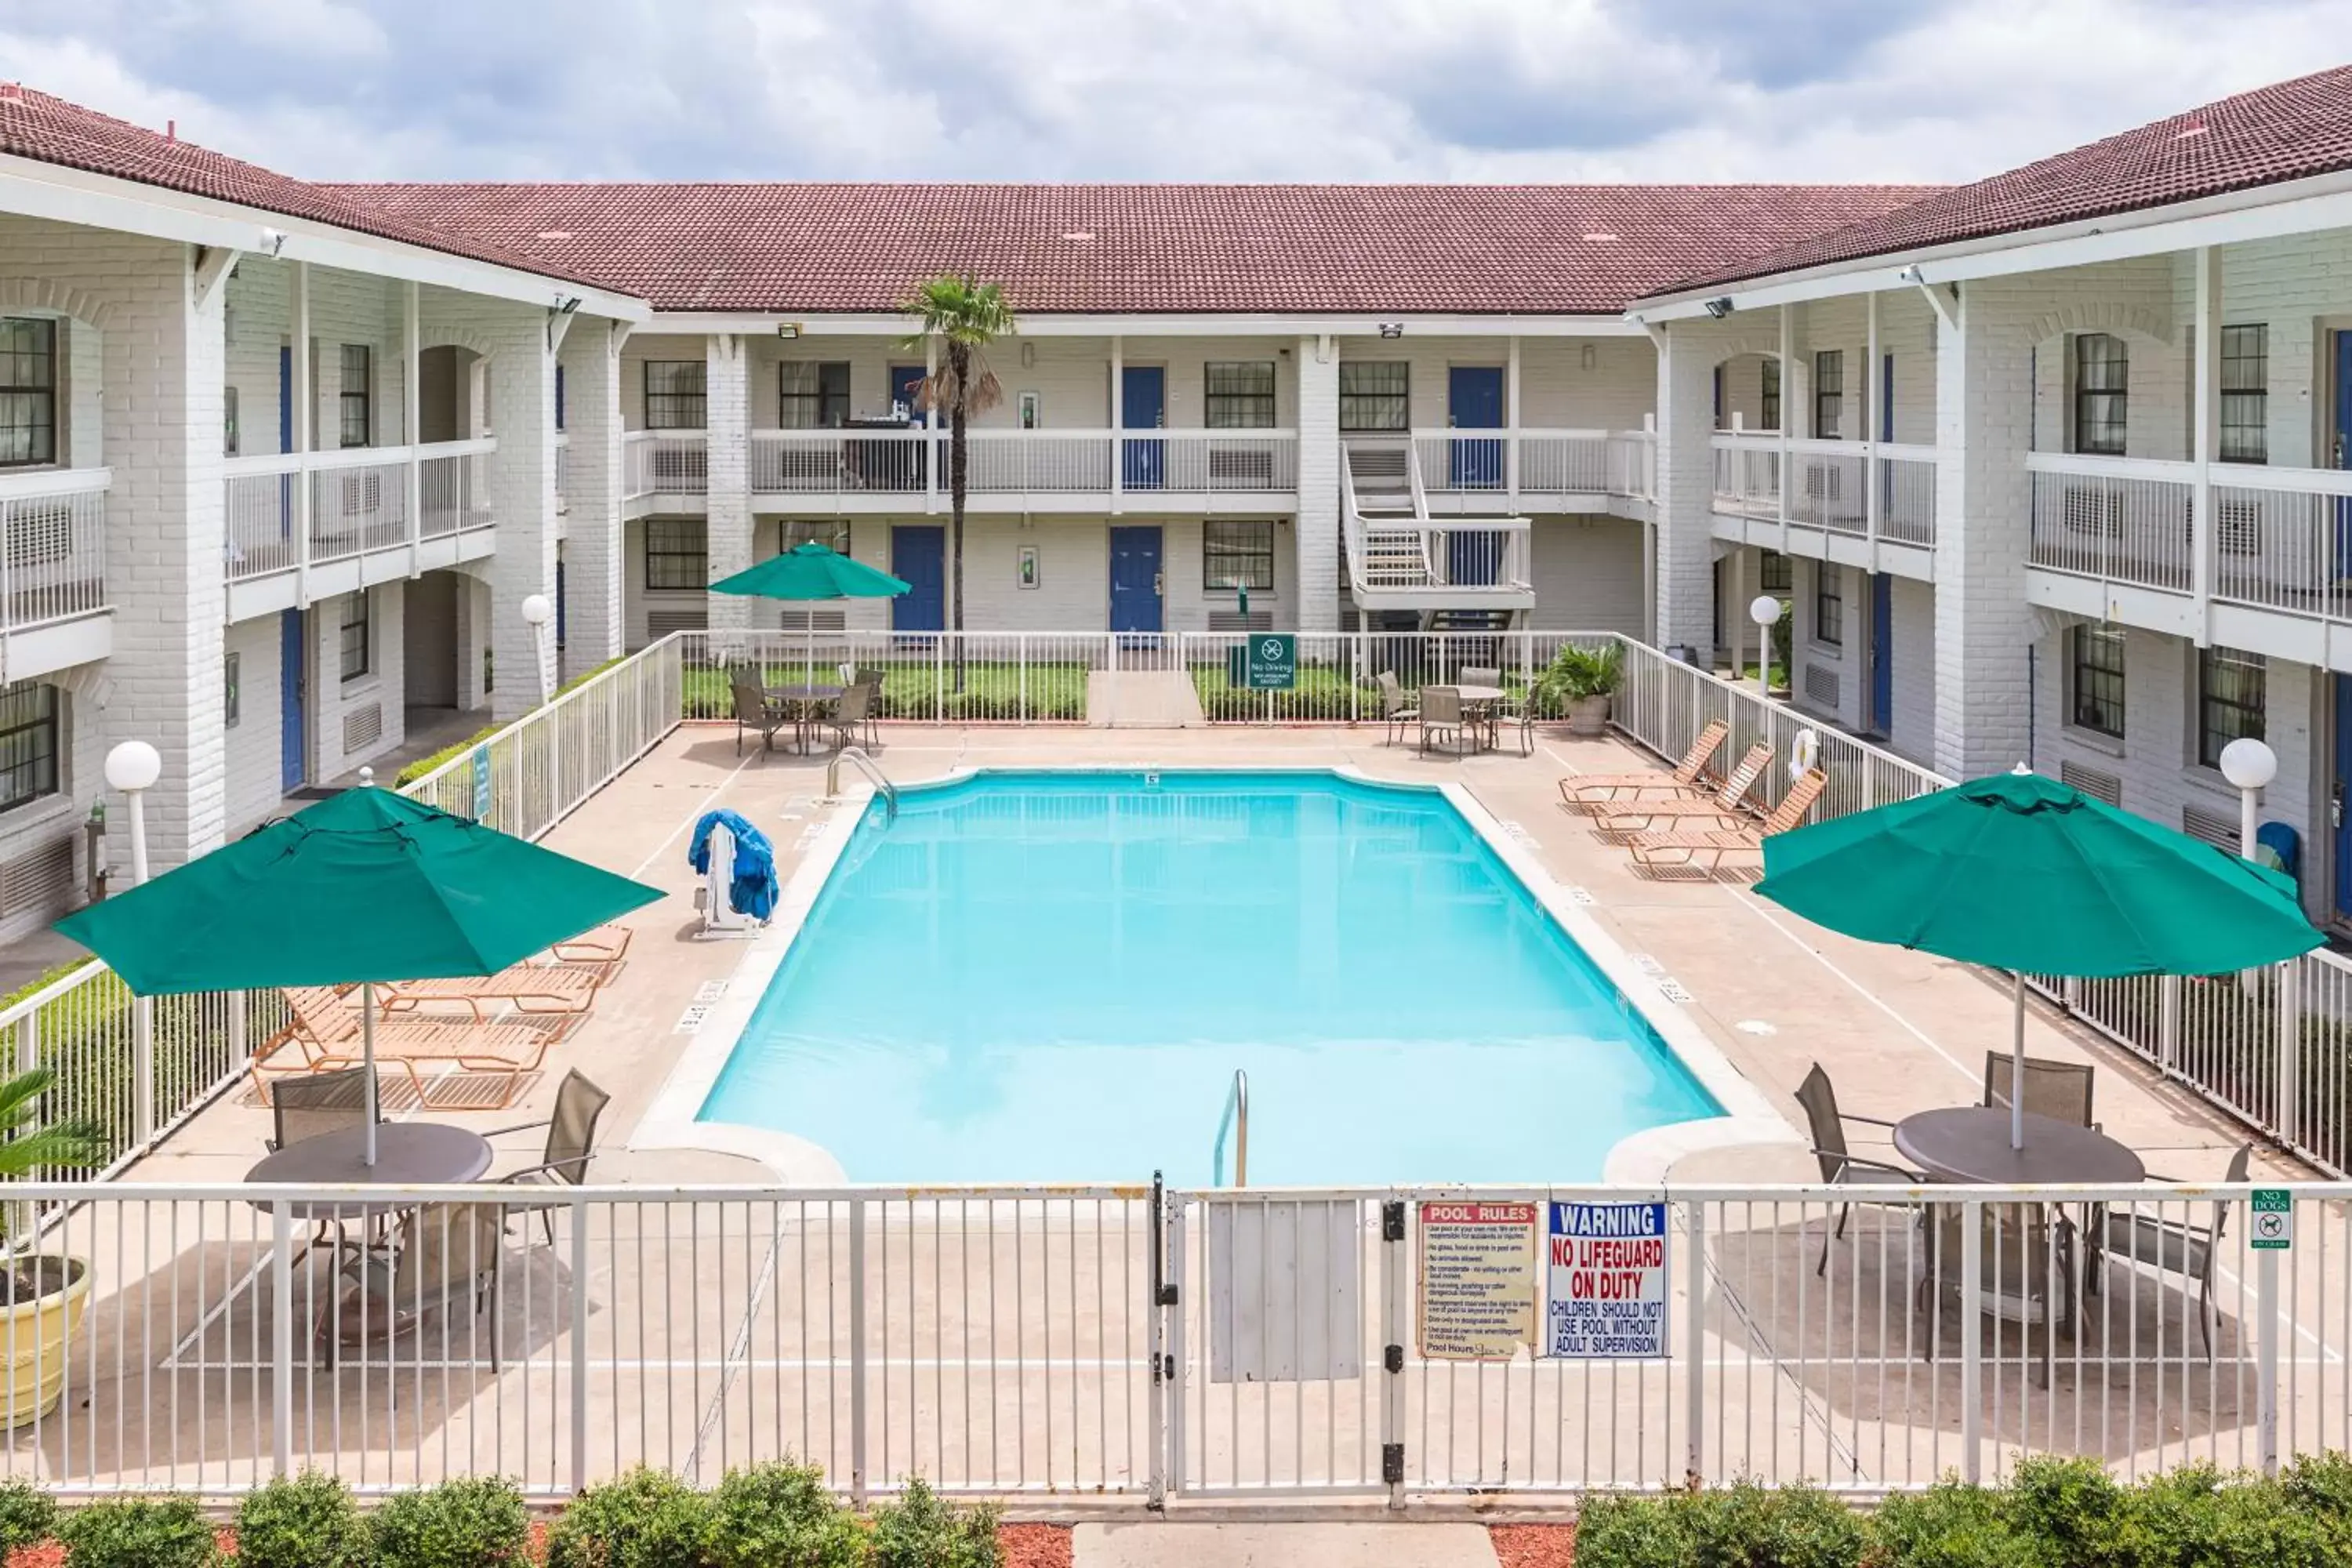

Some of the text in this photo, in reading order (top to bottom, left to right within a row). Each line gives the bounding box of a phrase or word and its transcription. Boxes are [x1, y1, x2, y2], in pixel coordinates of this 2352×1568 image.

[1251, 662, 1293, 673] No Diving
[2261, 1192, 2281, 1200] NO
[2256, 1201, 2288, 1211] DOGS
[1431, 1207, 1528, 1221] POOL RULES
[1559, 1205, 1655, 1235] WARNING
[1497, 1244, 1509, 1253] pool
[1552, 1238, 1663, 1269] NO LIFEGUARD
[1572, 1271, 1643, 1300] ON DUTY
[1551, 1301, 1663, 1318] CHILDREN SHOULD NOT
[1558, 1319, 1657, 1335] USE POOL WITHOUT
[1427, 1342, 1446, 1352] Pool
[1448, 1343, 1474, 1353] Hours
[1556, 1337, 1657, 1353] ADULT SUPERVISION
